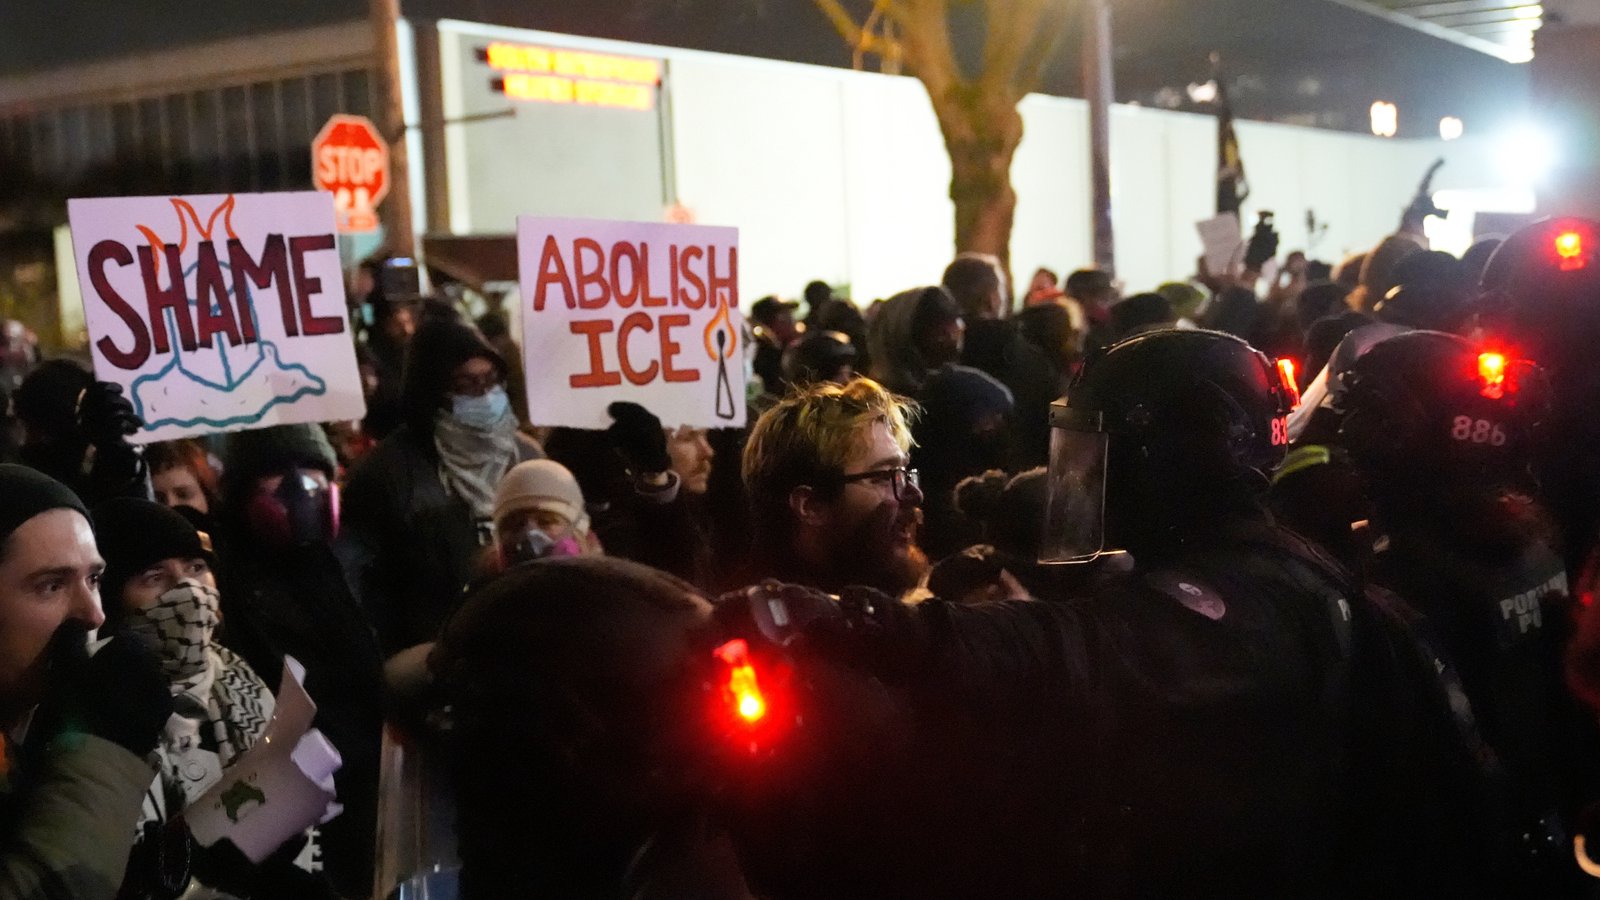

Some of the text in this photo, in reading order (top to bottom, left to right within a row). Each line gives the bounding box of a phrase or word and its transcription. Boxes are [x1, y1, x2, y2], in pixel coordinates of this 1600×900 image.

[319, 144, 380, 185] STOP
[88, 233, 344, 370] SHAME
[534, 235, 738, 311] ABOLISH
[569, 311, 700, 388] ICE
